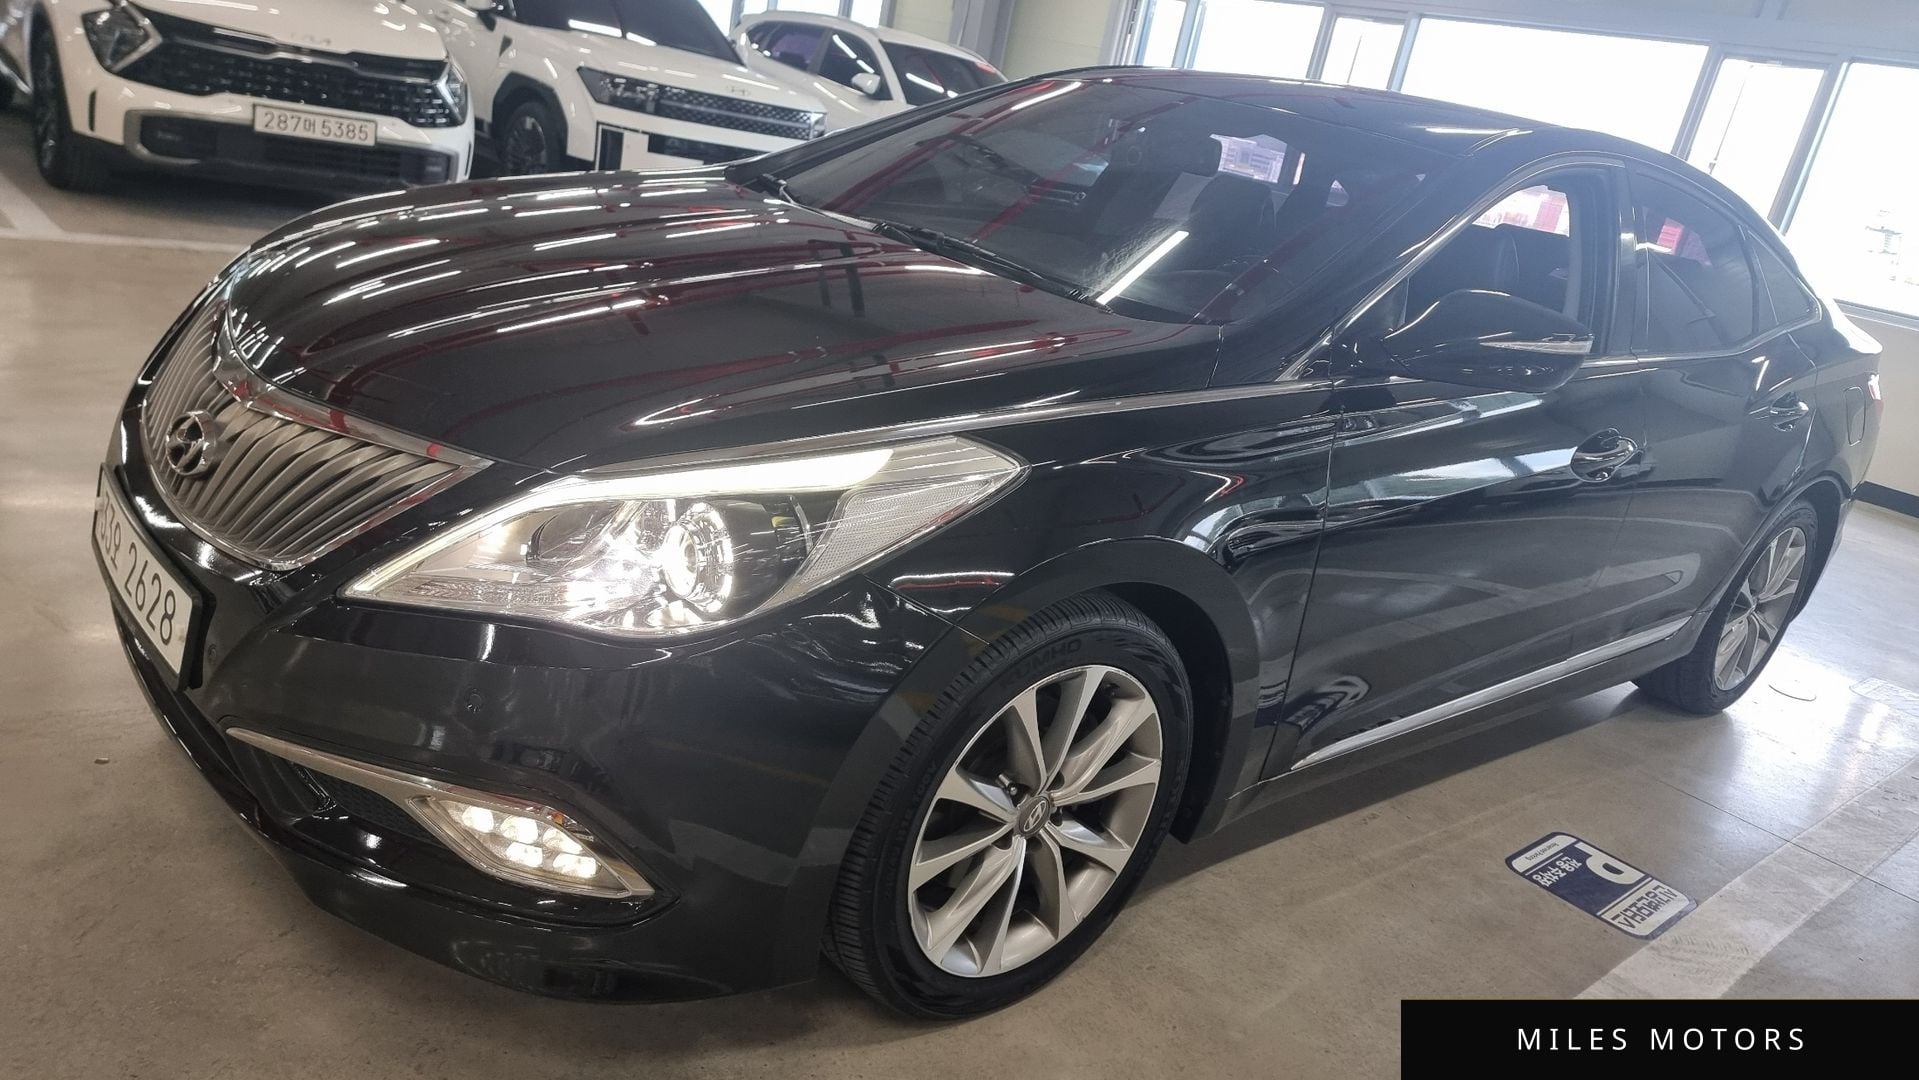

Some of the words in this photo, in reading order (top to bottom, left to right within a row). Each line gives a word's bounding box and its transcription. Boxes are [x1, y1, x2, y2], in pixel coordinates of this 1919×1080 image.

[321, 119, 369, 142] 5385
[124, 542, 177, 646] 2628
[1574, 842, 1646, 885] P
[1610, 884, 1678, 929] 신강변모터스
